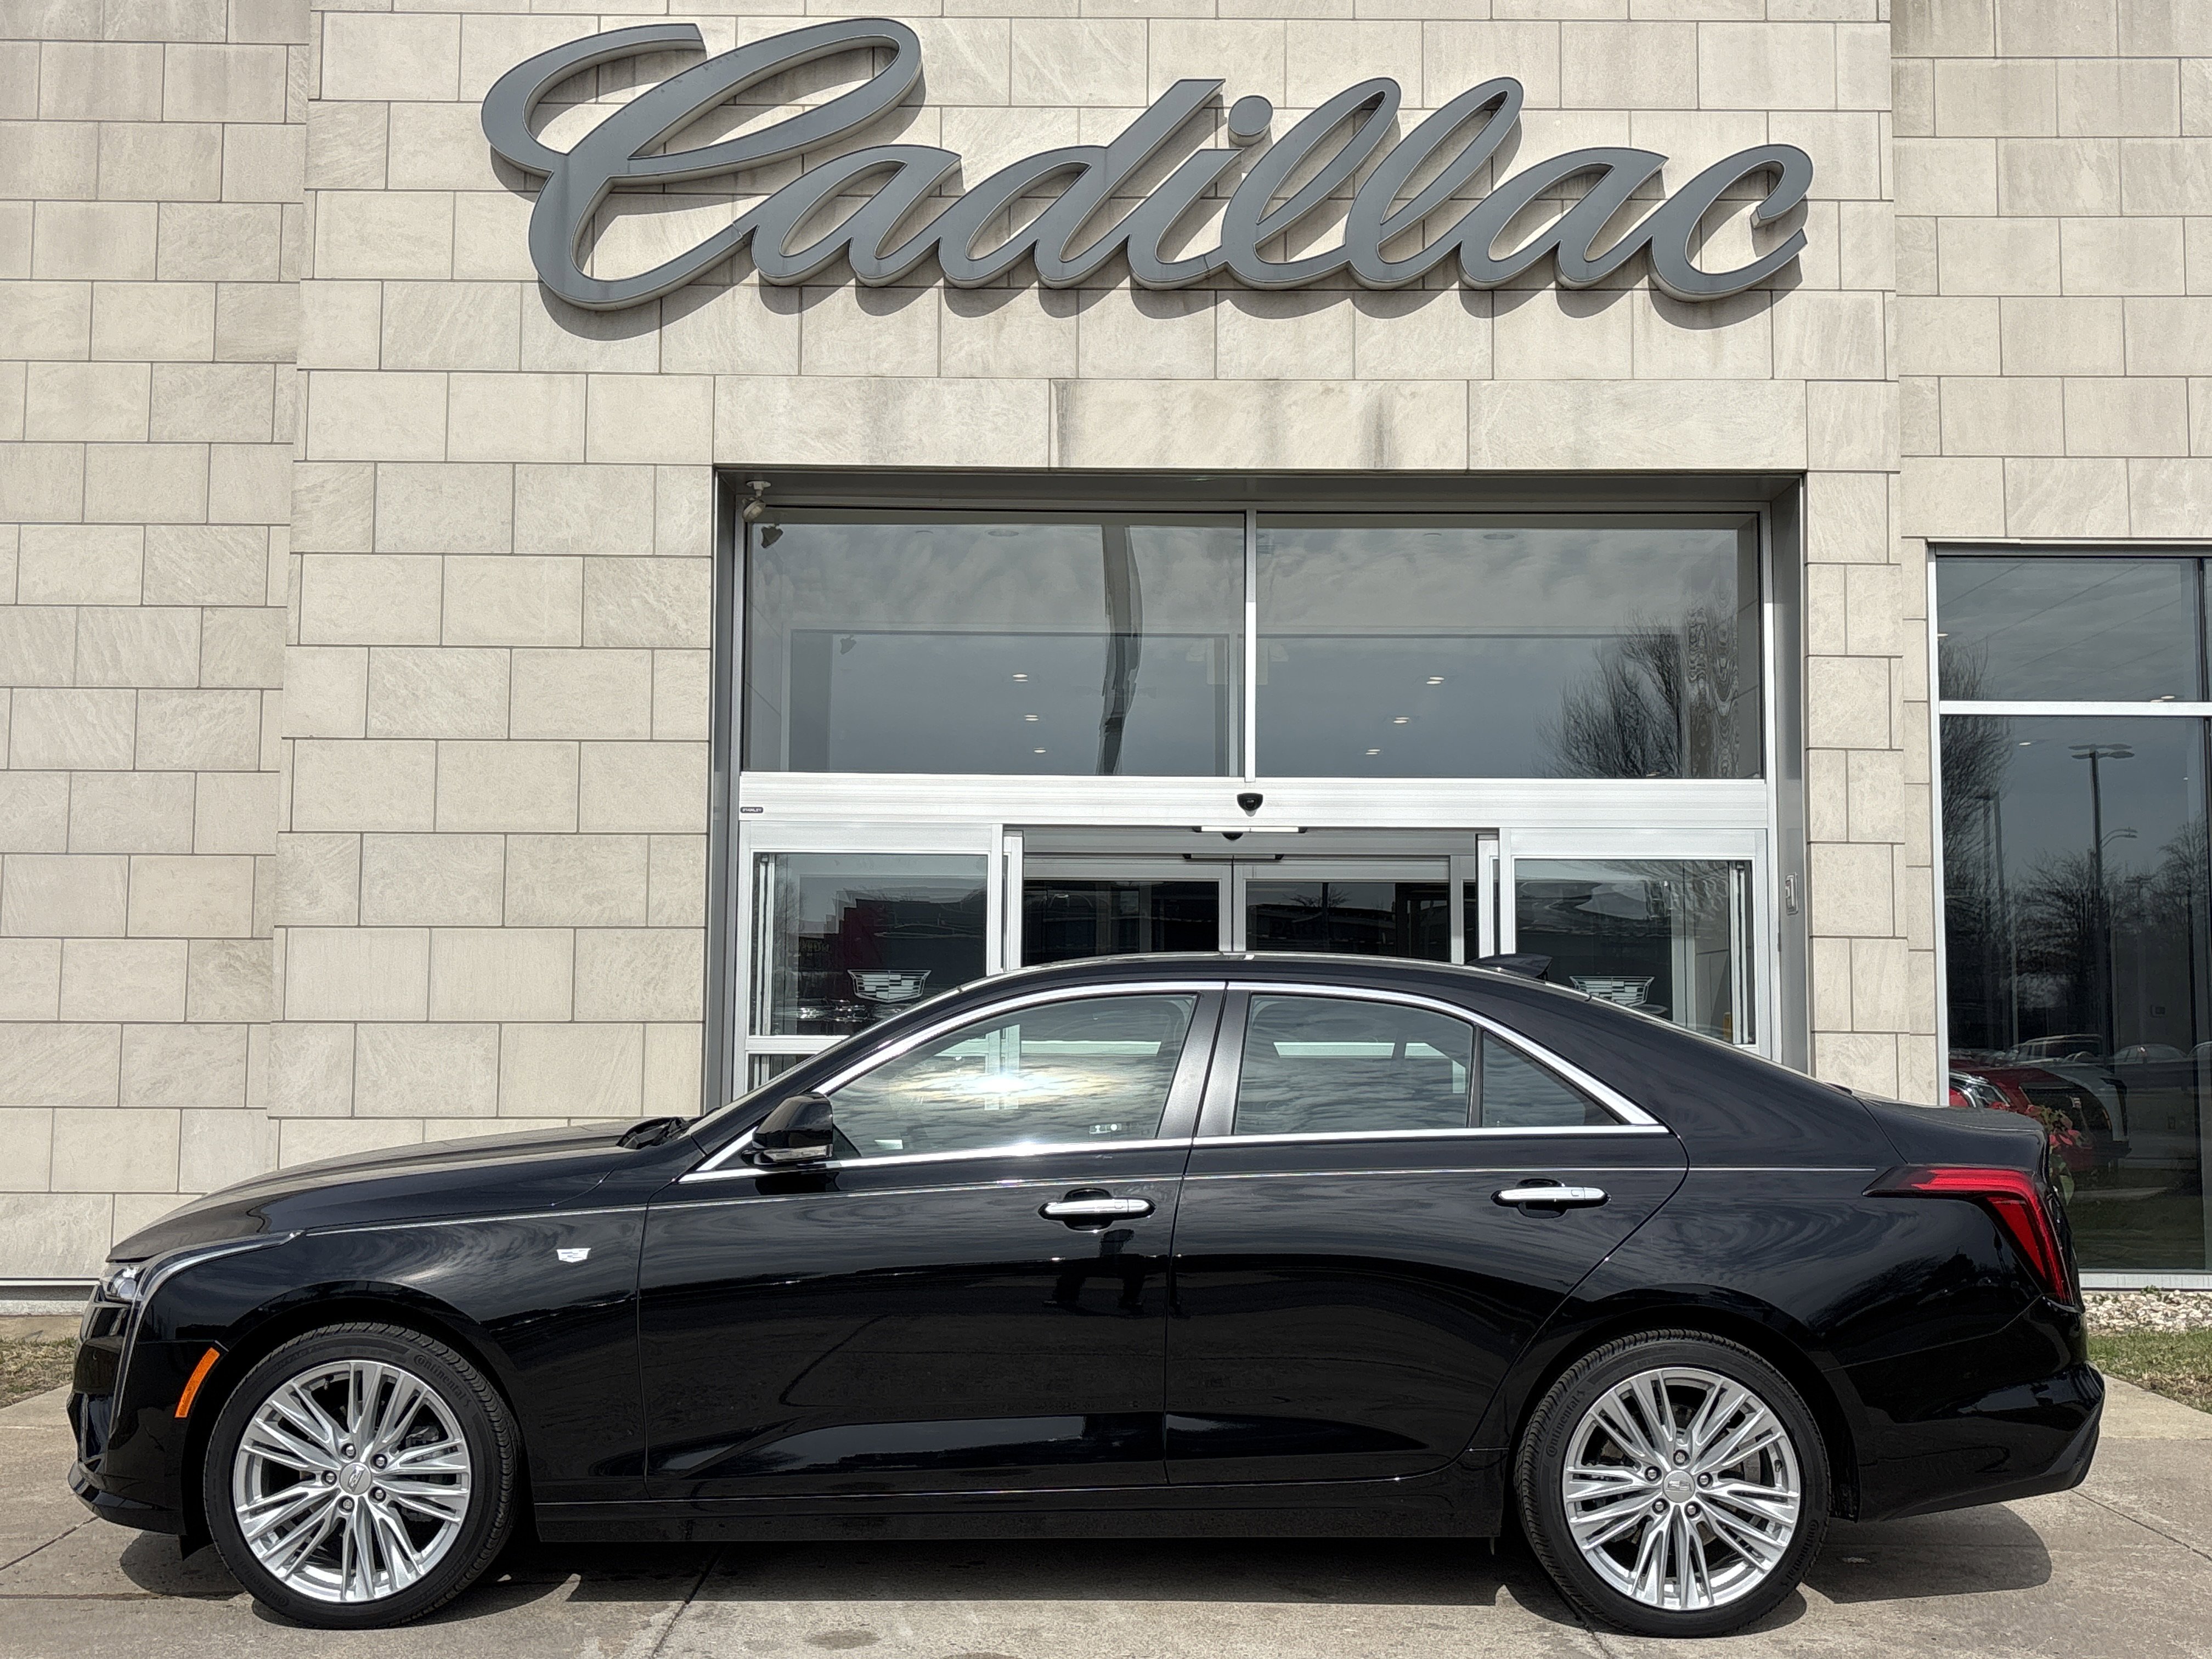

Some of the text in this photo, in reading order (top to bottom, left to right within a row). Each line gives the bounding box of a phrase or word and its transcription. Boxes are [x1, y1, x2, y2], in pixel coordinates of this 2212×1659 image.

[482, 18, 1814, 303] Cadillac
[414, 1355, 467, 1401] Continental
[1546, 1396, 1581, 1457] Continental
[1785, 1519, 1820, 1581] Continental
